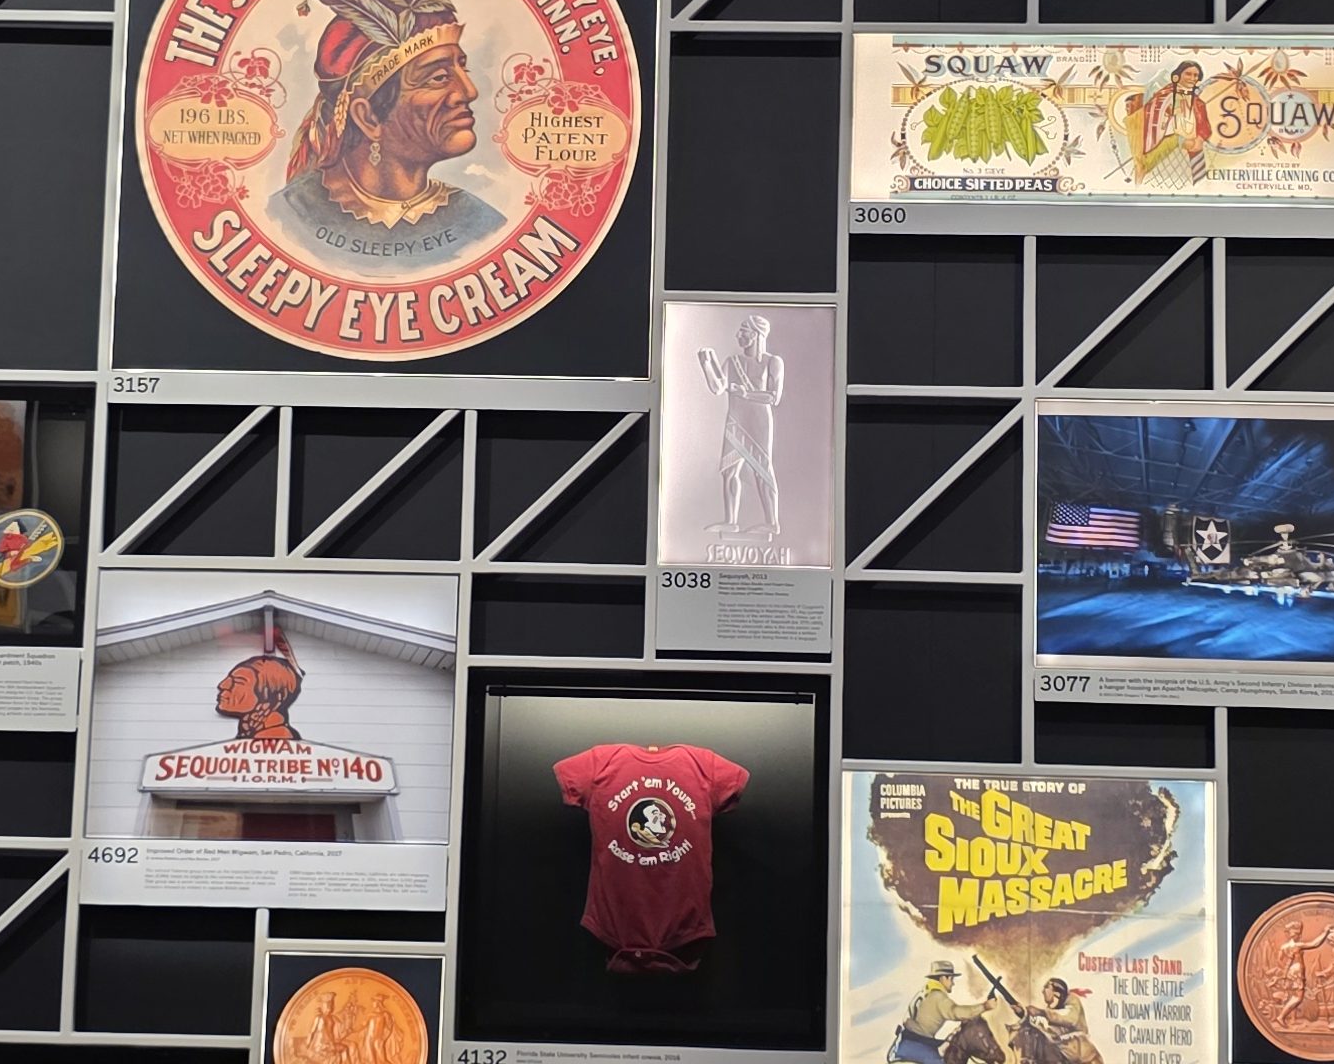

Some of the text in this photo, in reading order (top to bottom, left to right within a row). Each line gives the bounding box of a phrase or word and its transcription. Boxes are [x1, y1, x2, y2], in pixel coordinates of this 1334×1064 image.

[581, 11, 618, 76] EYE,
[370, 35, 435, 86] TRADE MARK
[924, 54, 1085, 78] SQUAW BRAND
[179, 108, 250, 125] 196 LBS.
[530, 111, 603, 128] HIGHEST
[163, 129, 262, 145] NET WHEN PACKED
[522, 126, 609, 145] PATENT
[535, 145, 597, 162] FLOUR
[913, 177, 1053, 191] CHOICE SIFTED PEAS
[1206, 168, 1273, 182] CENTERVILLE
[1275, 170, 1319, 183] CANNING
[854, 207, 906, 225] 3060
[315, 225, 458, 257] OLD SLEEPY EYE
[193, 209, 579, 343] SLEEPY EYE CREAM
[113, 376, 161, 394] 3157
[661, 571, 711, 589] 3038
[1040, 674, 1091, 693] 3077
[223, 738, 312, 755] WIGWAM
[155, 755, 383, 783] SEQUOIA TRIBE 140
[608, 779, 639, 812] Start
[641, 776, 663, 789] 'em
[880, 784, 926, 798] COLUMBIA
[953, 777, 1087, 795] THE TRUE STORY OF
[880, 797, 923, 810] PICTURES
[949, 788, 1092, 851] THE GREAT
[608, 839, 636, 864] Raise
[637, 853, 658, 867] 'em
[924, 812, 1050, 878] SIOUX
[87, 846, 139, 865] 4692
[937, 858, 1128, 934] MASSACRE
[1078, 951, 1123, 974] CUSTER'S
[1125, 954, 1149, 975] LAST
[1112, 975, 1185, 998] THE ONE BATTLE
[1105, 999, 1192, 1022] NO INDIAN WARRIOR
[1114, 1023, 1193, 1047] OR CAVALRY HERO
[457, 1049, 507, 1064] 4132
